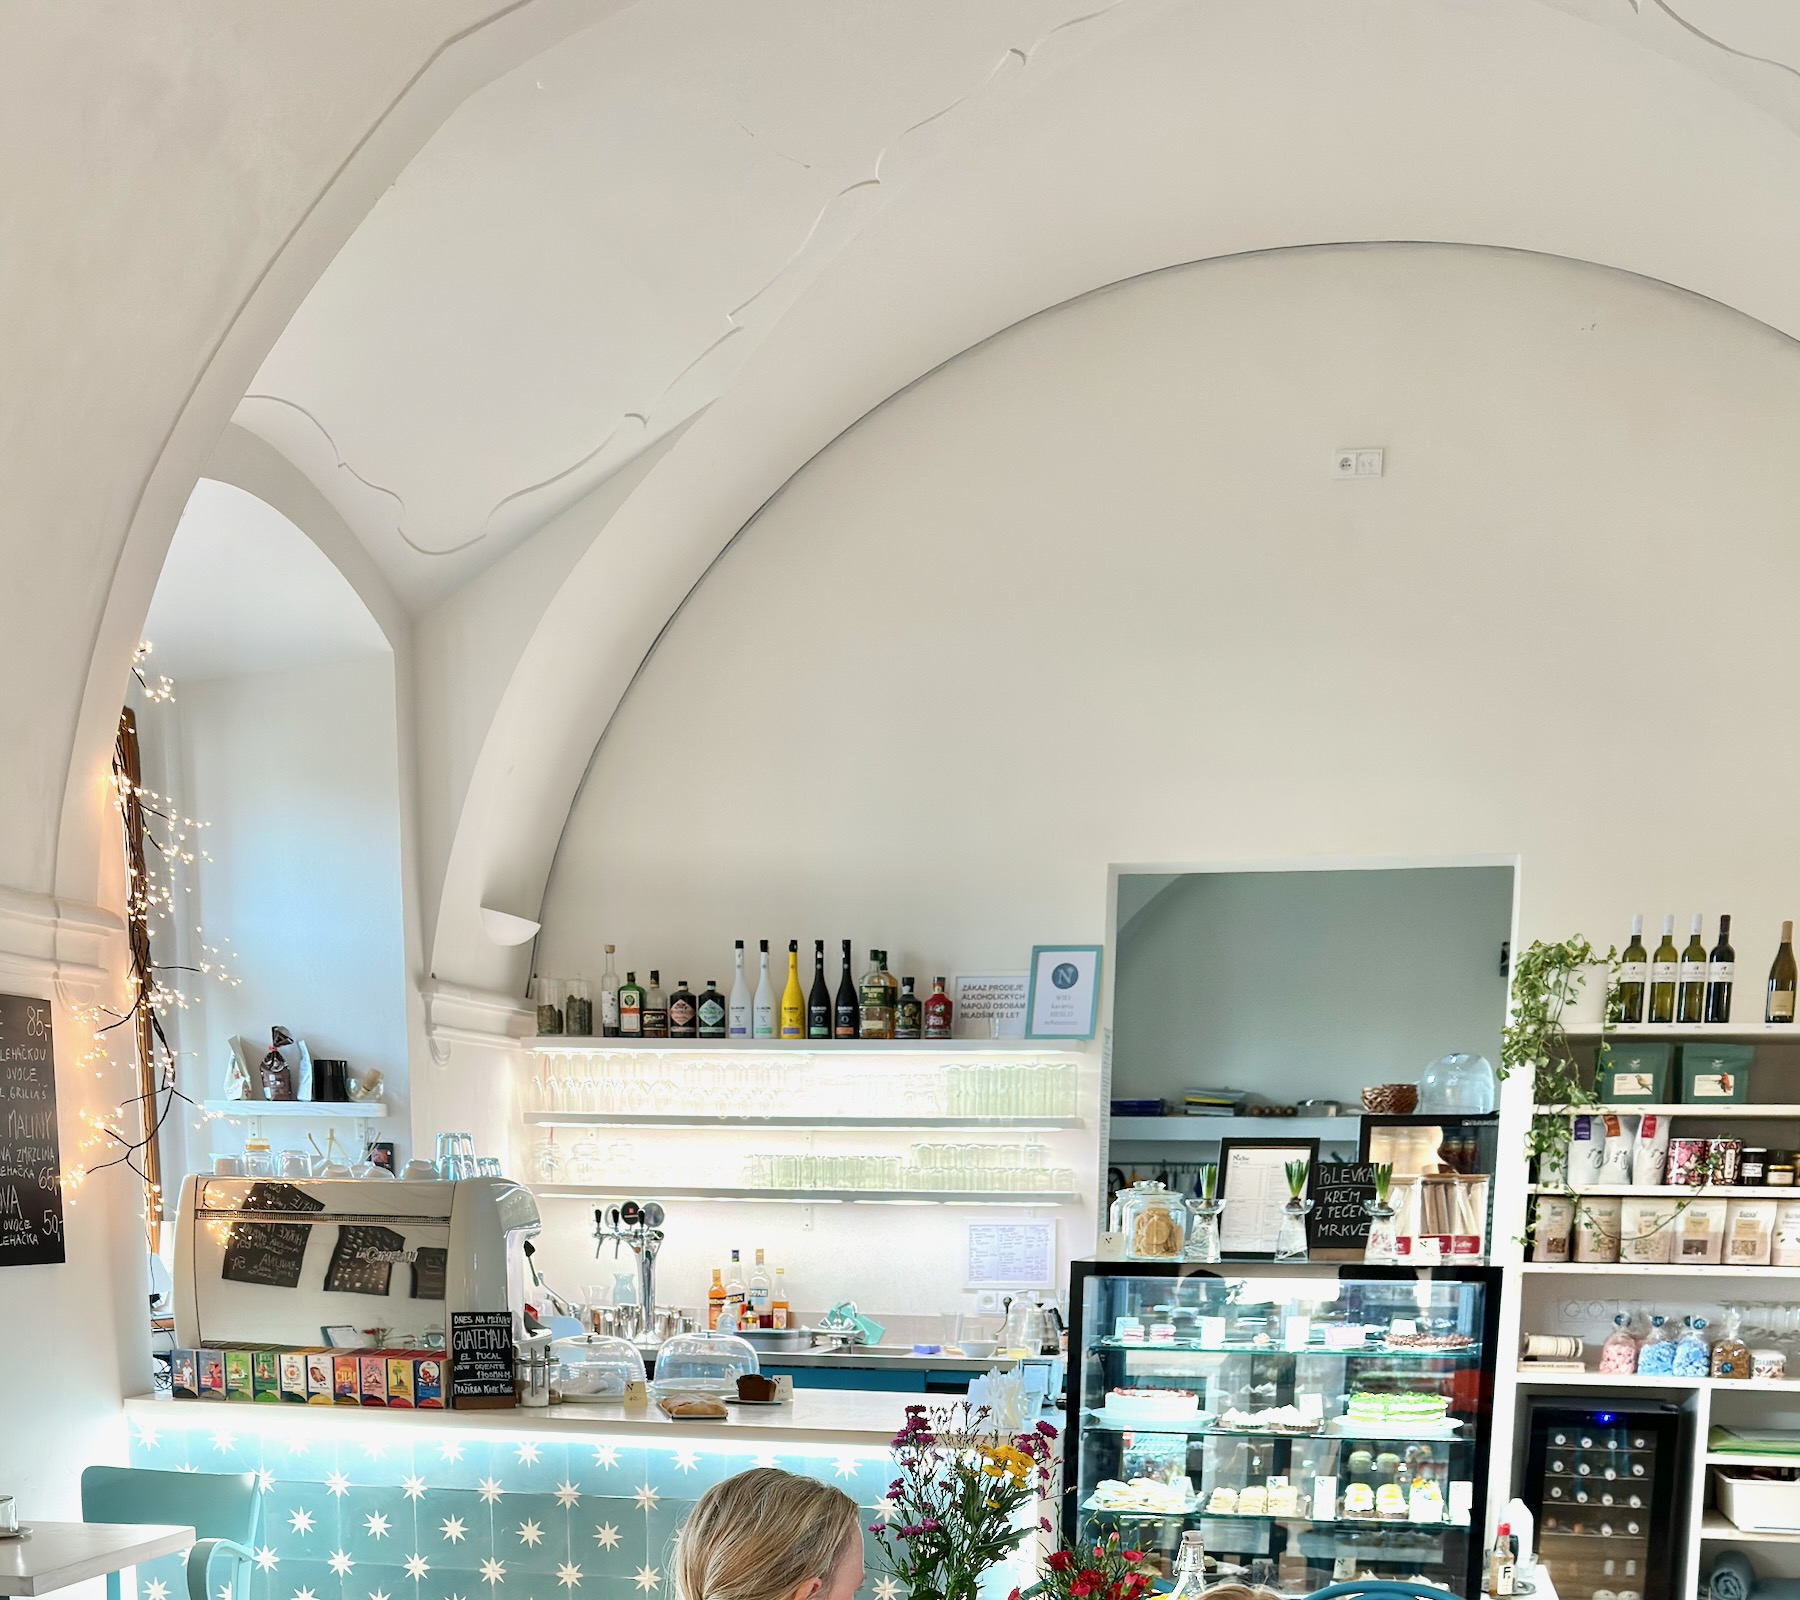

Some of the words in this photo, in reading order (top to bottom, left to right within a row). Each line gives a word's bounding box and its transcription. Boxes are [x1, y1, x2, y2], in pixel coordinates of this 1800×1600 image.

[989, 984, 1024, 992] PRODEJE
[1005, 1011, 1020, 1019] LET
[8, 1109, 52, 1140] MALINY
[17, 1146, 55, 1167] ZMRZLINA
[1324, 1188, 1360, 1204] KRÉM
[3, 1219, 32, 1231] OVOCE
[454, 1315, 473, 1324] DNES
[475, 1315, 486, 1324] NA
[453, 1328, 511, 1350] GUATEMALA
[460, 1353, 471, 1361] EL
